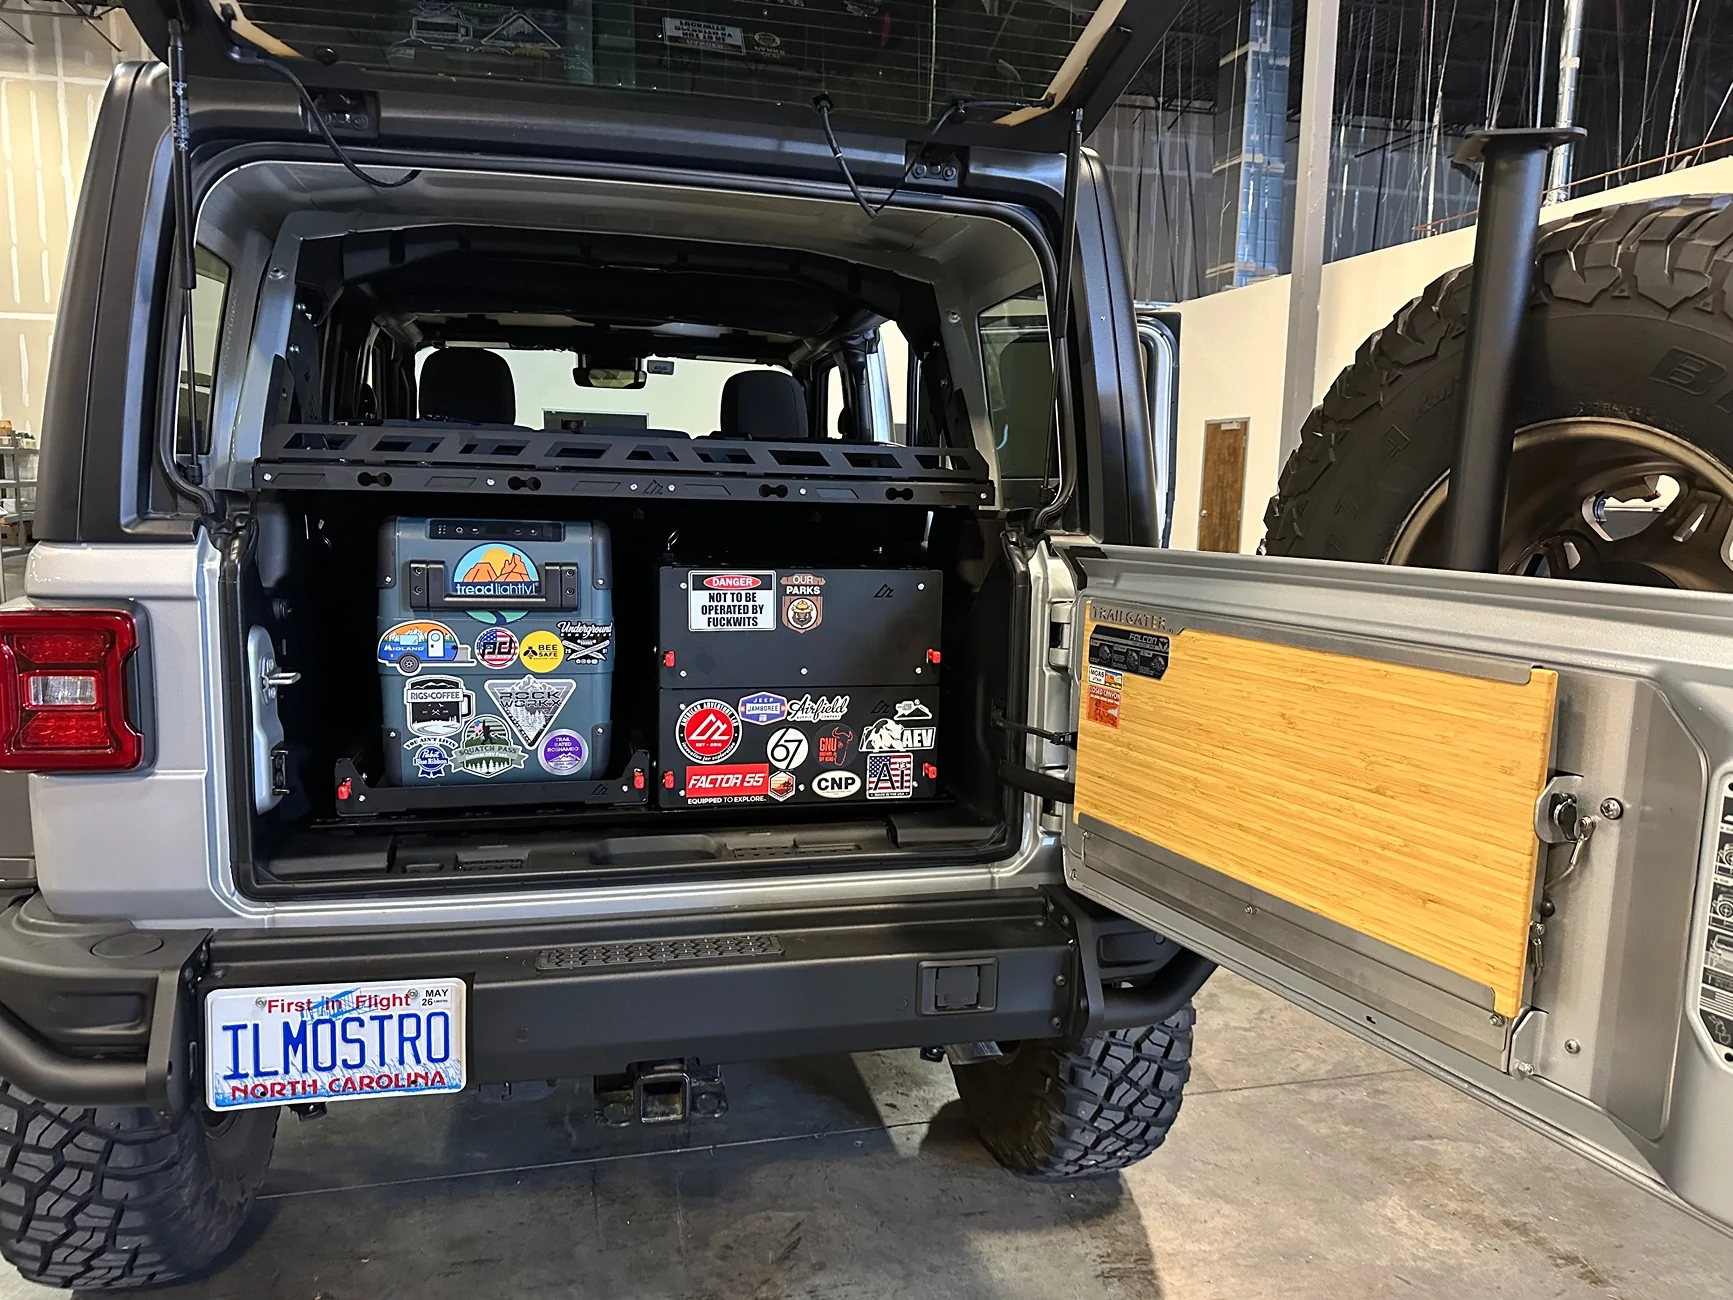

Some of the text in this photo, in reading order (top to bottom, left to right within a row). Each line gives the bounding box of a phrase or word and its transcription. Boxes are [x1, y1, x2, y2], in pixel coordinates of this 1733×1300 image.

[712, 577, 753, 587] DANGER
[792, 575, 814, 584] OUR
[456, 582, 494, 595] tread
[786, 586, 821, 595] PARKS
[708, 592, 757, 603] NOT TO BE
[701, 604, 765, 615] OPERATED BY
[707, 616, 759, 627] FUCKWITS
[1092, 605, 1166, 630] TRAILGATER
[557, 621, 613, 639] Underground
[1129, 632, 1158, 645] FALCON
[384, 643, 424, 651] MIDLAND
[1090, 669, 1105, 678] MOAB
[500, 691, 560, 699] ROCK
[788, 696, 848, 720] Airfield
[680, 704, 701, 727] AMERICAN
[703, 702, 733, 717] ADVENTURE
[820, 737, 837, 751] GNU
[902, 728, 934, 748] AEV
[459, 745, 517, 755] SQUATCH PASS
[771, 727, 804, 770] 67
[688, 772, 766, 789] FACTOR 55
[817, 776, 856, 791] CNP
[687, 797, 723, 805] EQUIPPED
[425, 989, 449, 998] MAY
[267, 998, 313, 1014] First
[356, 992, 411, 1011] Flight
[421, 998, 433, 1007] 26
[231, 1070, 446, 1101] NORTH CAROLINA
